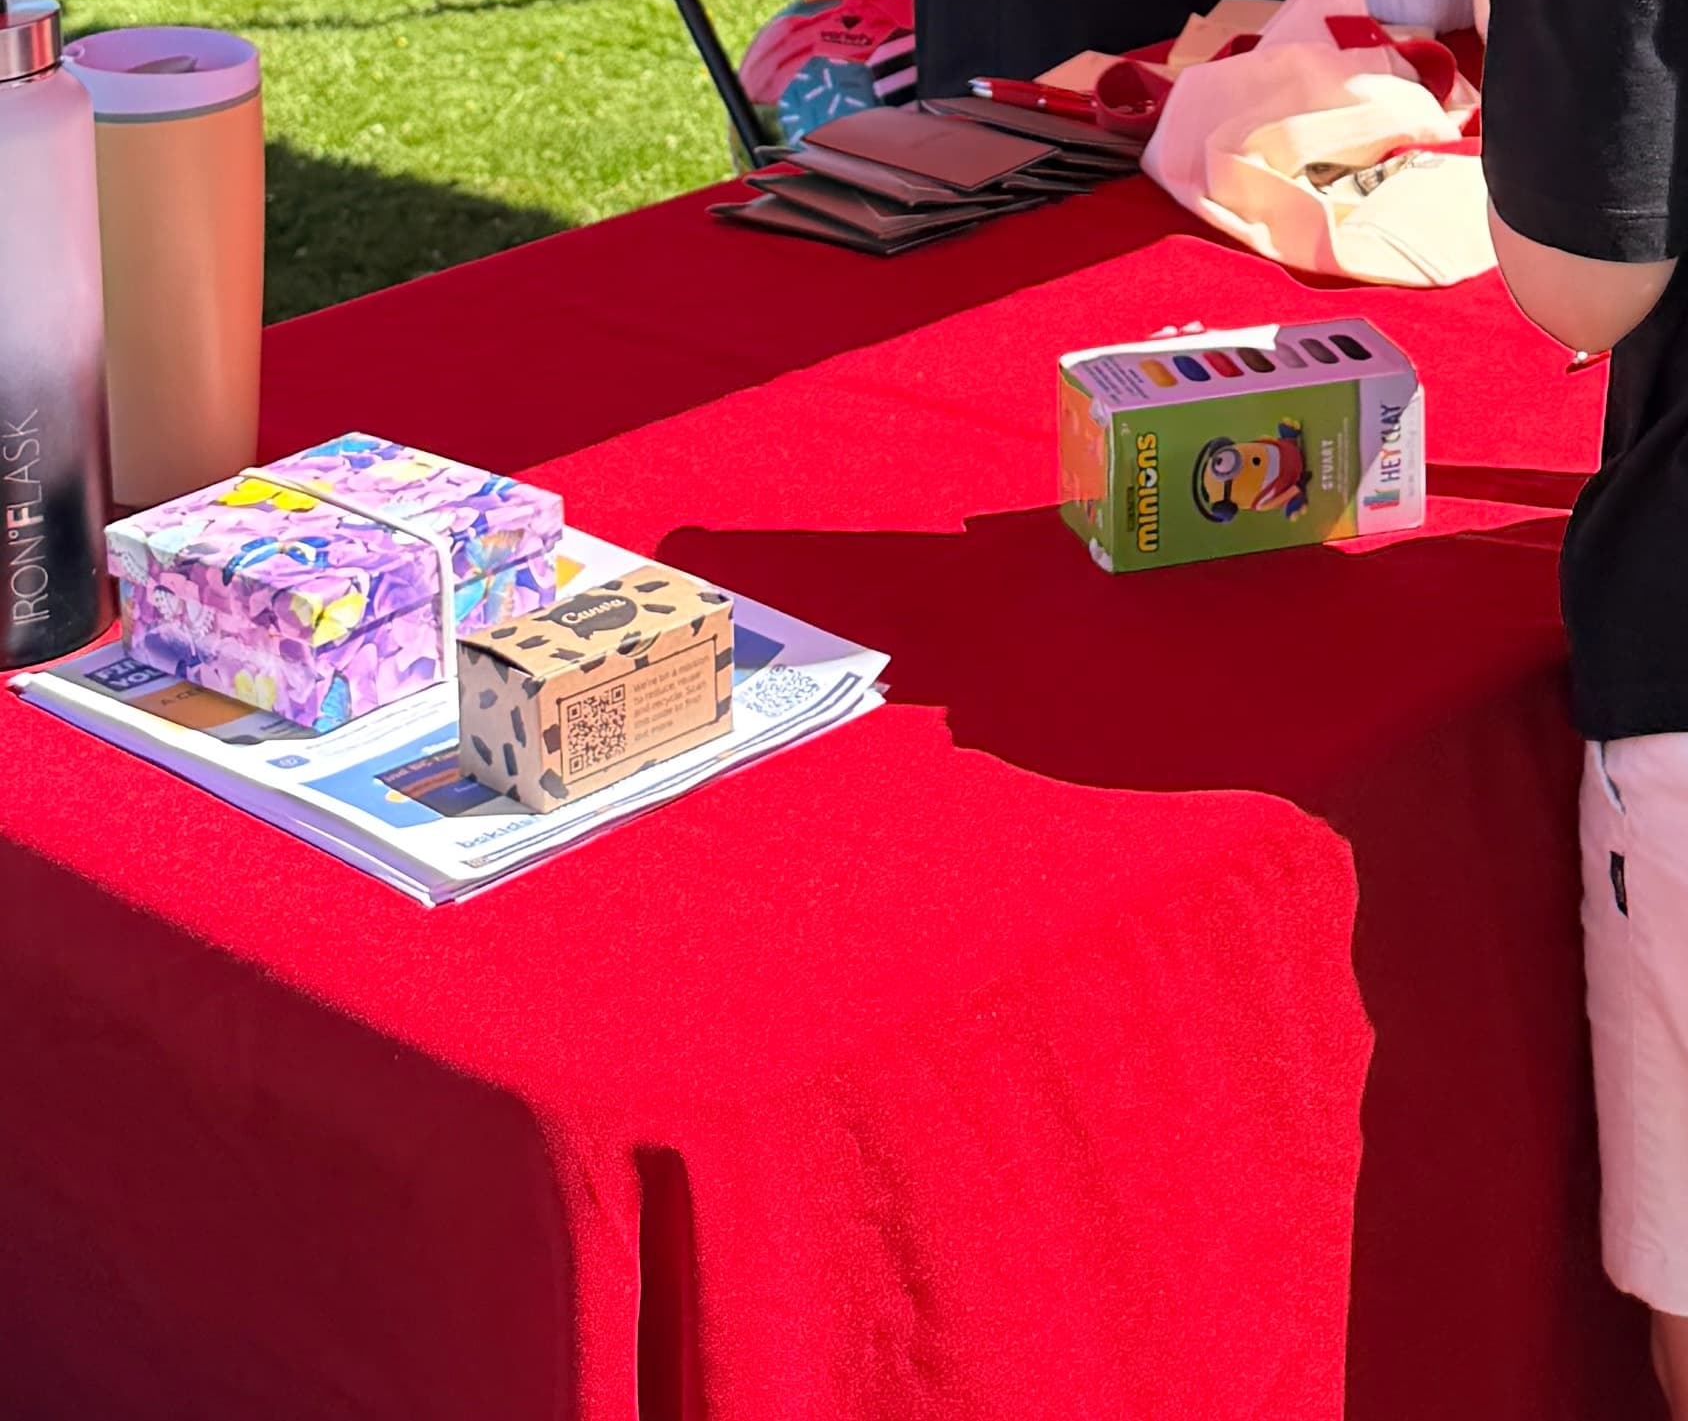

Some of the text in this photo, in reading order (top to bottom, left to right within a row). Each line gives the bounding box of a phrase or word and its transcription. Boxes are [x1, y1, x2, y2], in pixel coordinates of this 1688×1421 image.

[1321, 439, 1335, 490] STUART
[1380, 404, 1402, 483] HEY CLAY
[561, 599, 626, 624] Canva
